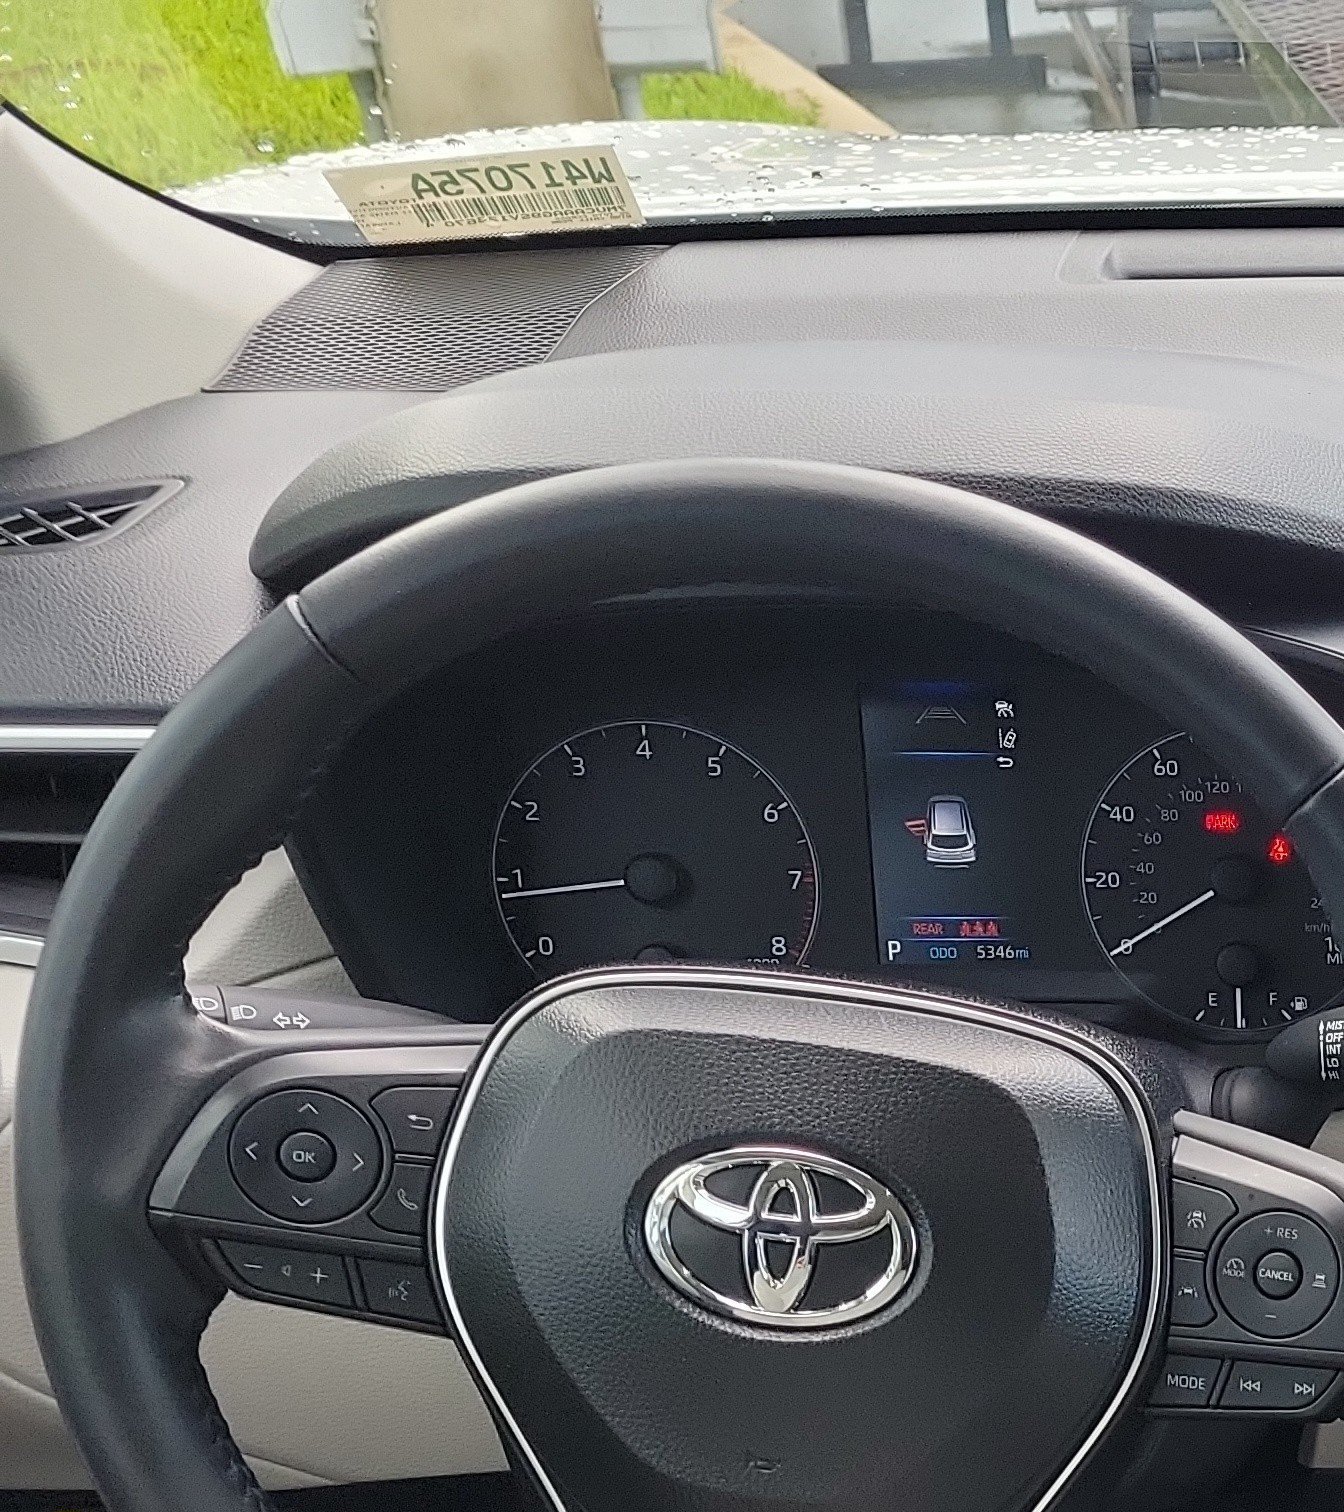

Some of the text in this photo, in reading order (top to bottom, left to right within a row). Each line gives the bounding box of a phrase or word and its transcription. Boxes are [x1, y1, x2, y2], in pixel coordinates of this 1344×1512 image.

[635, 739, 653, 760] 4
[572, 757, 586, 776] 3
[707, 757, 722, 776] 5
[1154, 760, 1178, 776] 60
[1204, 781, 1230, 794] 120
[1179, 789, 1204, 803] 100
[525, 802, 540, 821] 2
[763, 804, 779, 822] 6
[1109, 805, 1135, 822] 40
[1160, 809, 1179, 822] 80
[1144, 832, 1162, 845] 60
[1136, 862, 1155, 875] 40
[511, 869, 523, 888] 1
[787, 871, 802, 890] 7
[1095, 871, 1120, 888] 20
[1139, 892, 1157, 904] 20
[913, 923, 943, 935] REAR
[1304, 922, 1331, 933] km/h
[538, 936, 553, 955] 0
[772, 936, 786, 955] 8
[888, 940, 901, 961] P
[930, 946, 957, 960] ODO
[1208, 993, 1218, 1006] E
[1269, 993, 1278, 1006] F
[1325, 1032, 1344, 1043] OFF
[1325, 1044, 1342, 1055] INT
[1326, 1058, 1339, 1068] LO
[1327, 1070, 1340, 1080] HI
[292, 1150, 316, 1164] OK
[1276, 1227, 1299, 1240] RES
[1222, 1268, 1245, 1278] MODE
[1258, 1268, 1294, 1283] CANCEL
[1167, 1373, 1207, 1391] MODE
